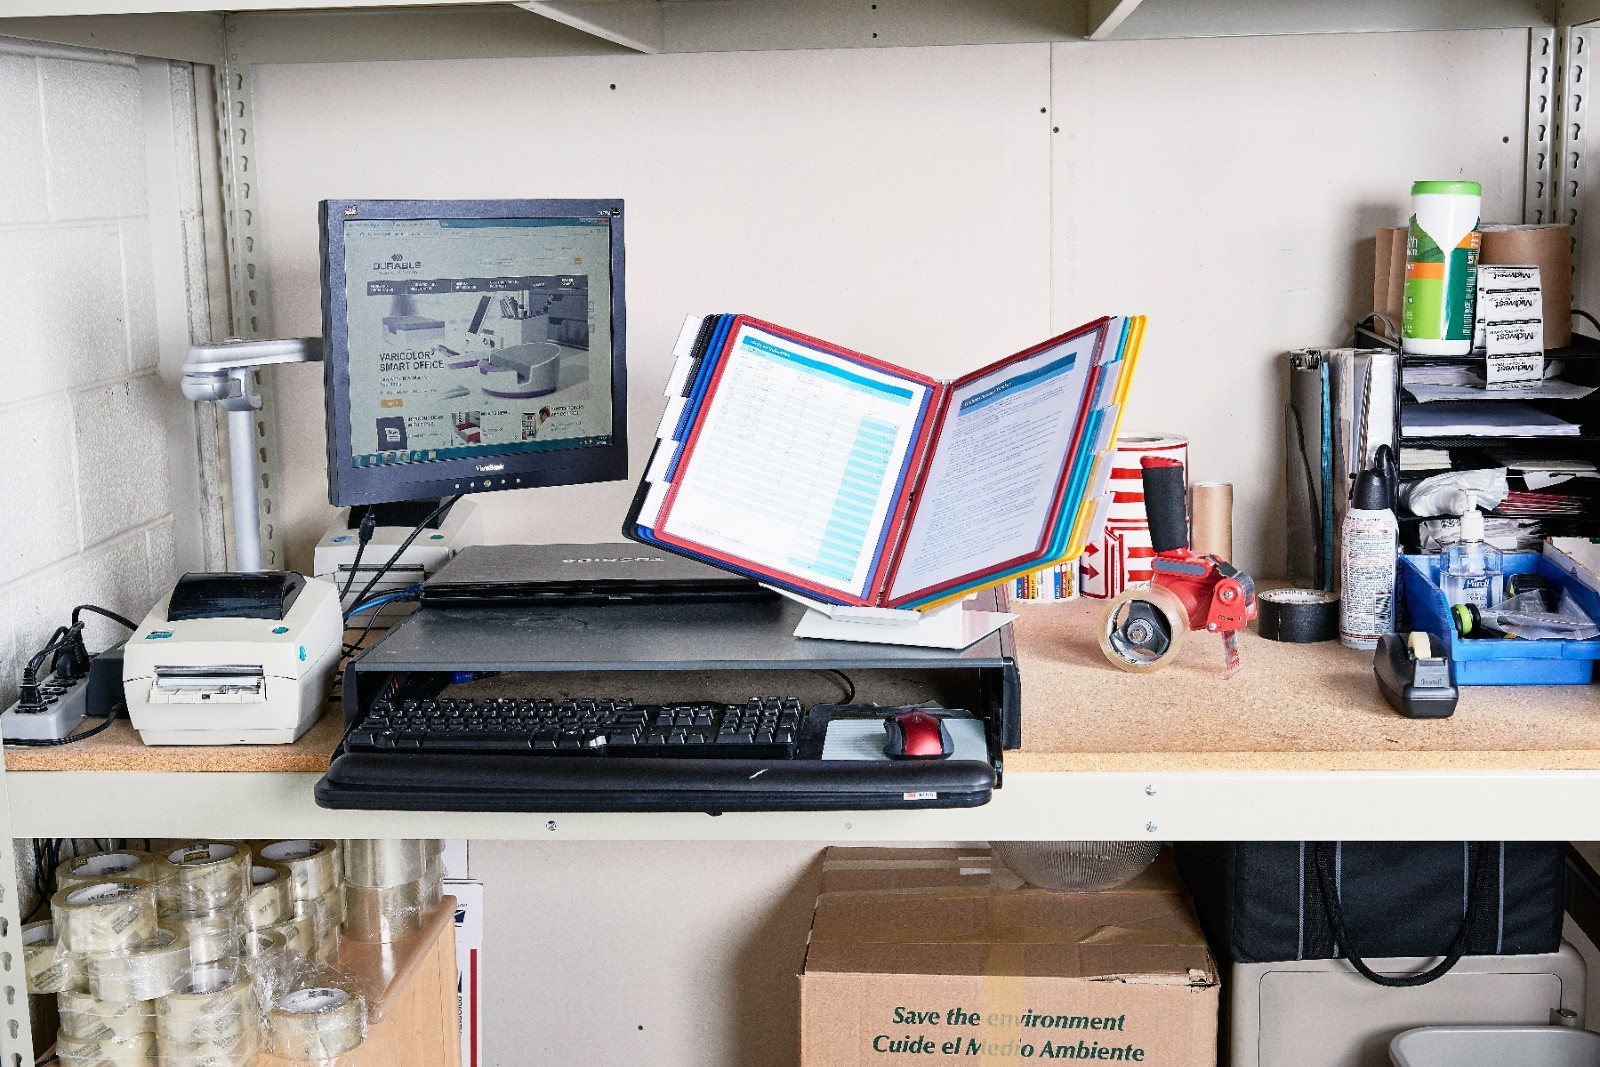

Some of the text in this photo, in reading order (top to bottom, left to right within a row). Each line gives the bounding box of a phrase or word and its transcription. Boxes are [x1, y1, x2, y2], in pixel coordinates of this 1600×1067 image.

[373, 261, 422, 270] DURABLE
[1494, 298, 1533, 309] Midwest
[1496, 331, 1534, 342] Midwest
[380, 359, 444, 372] SMART OFFICE
[1497, 363, 1534, 373] Midwest
[892, 1006, 1126, 1032] Save the environment
[872, 1034, 1145, 1062] Cuide el Medio Ambiente
